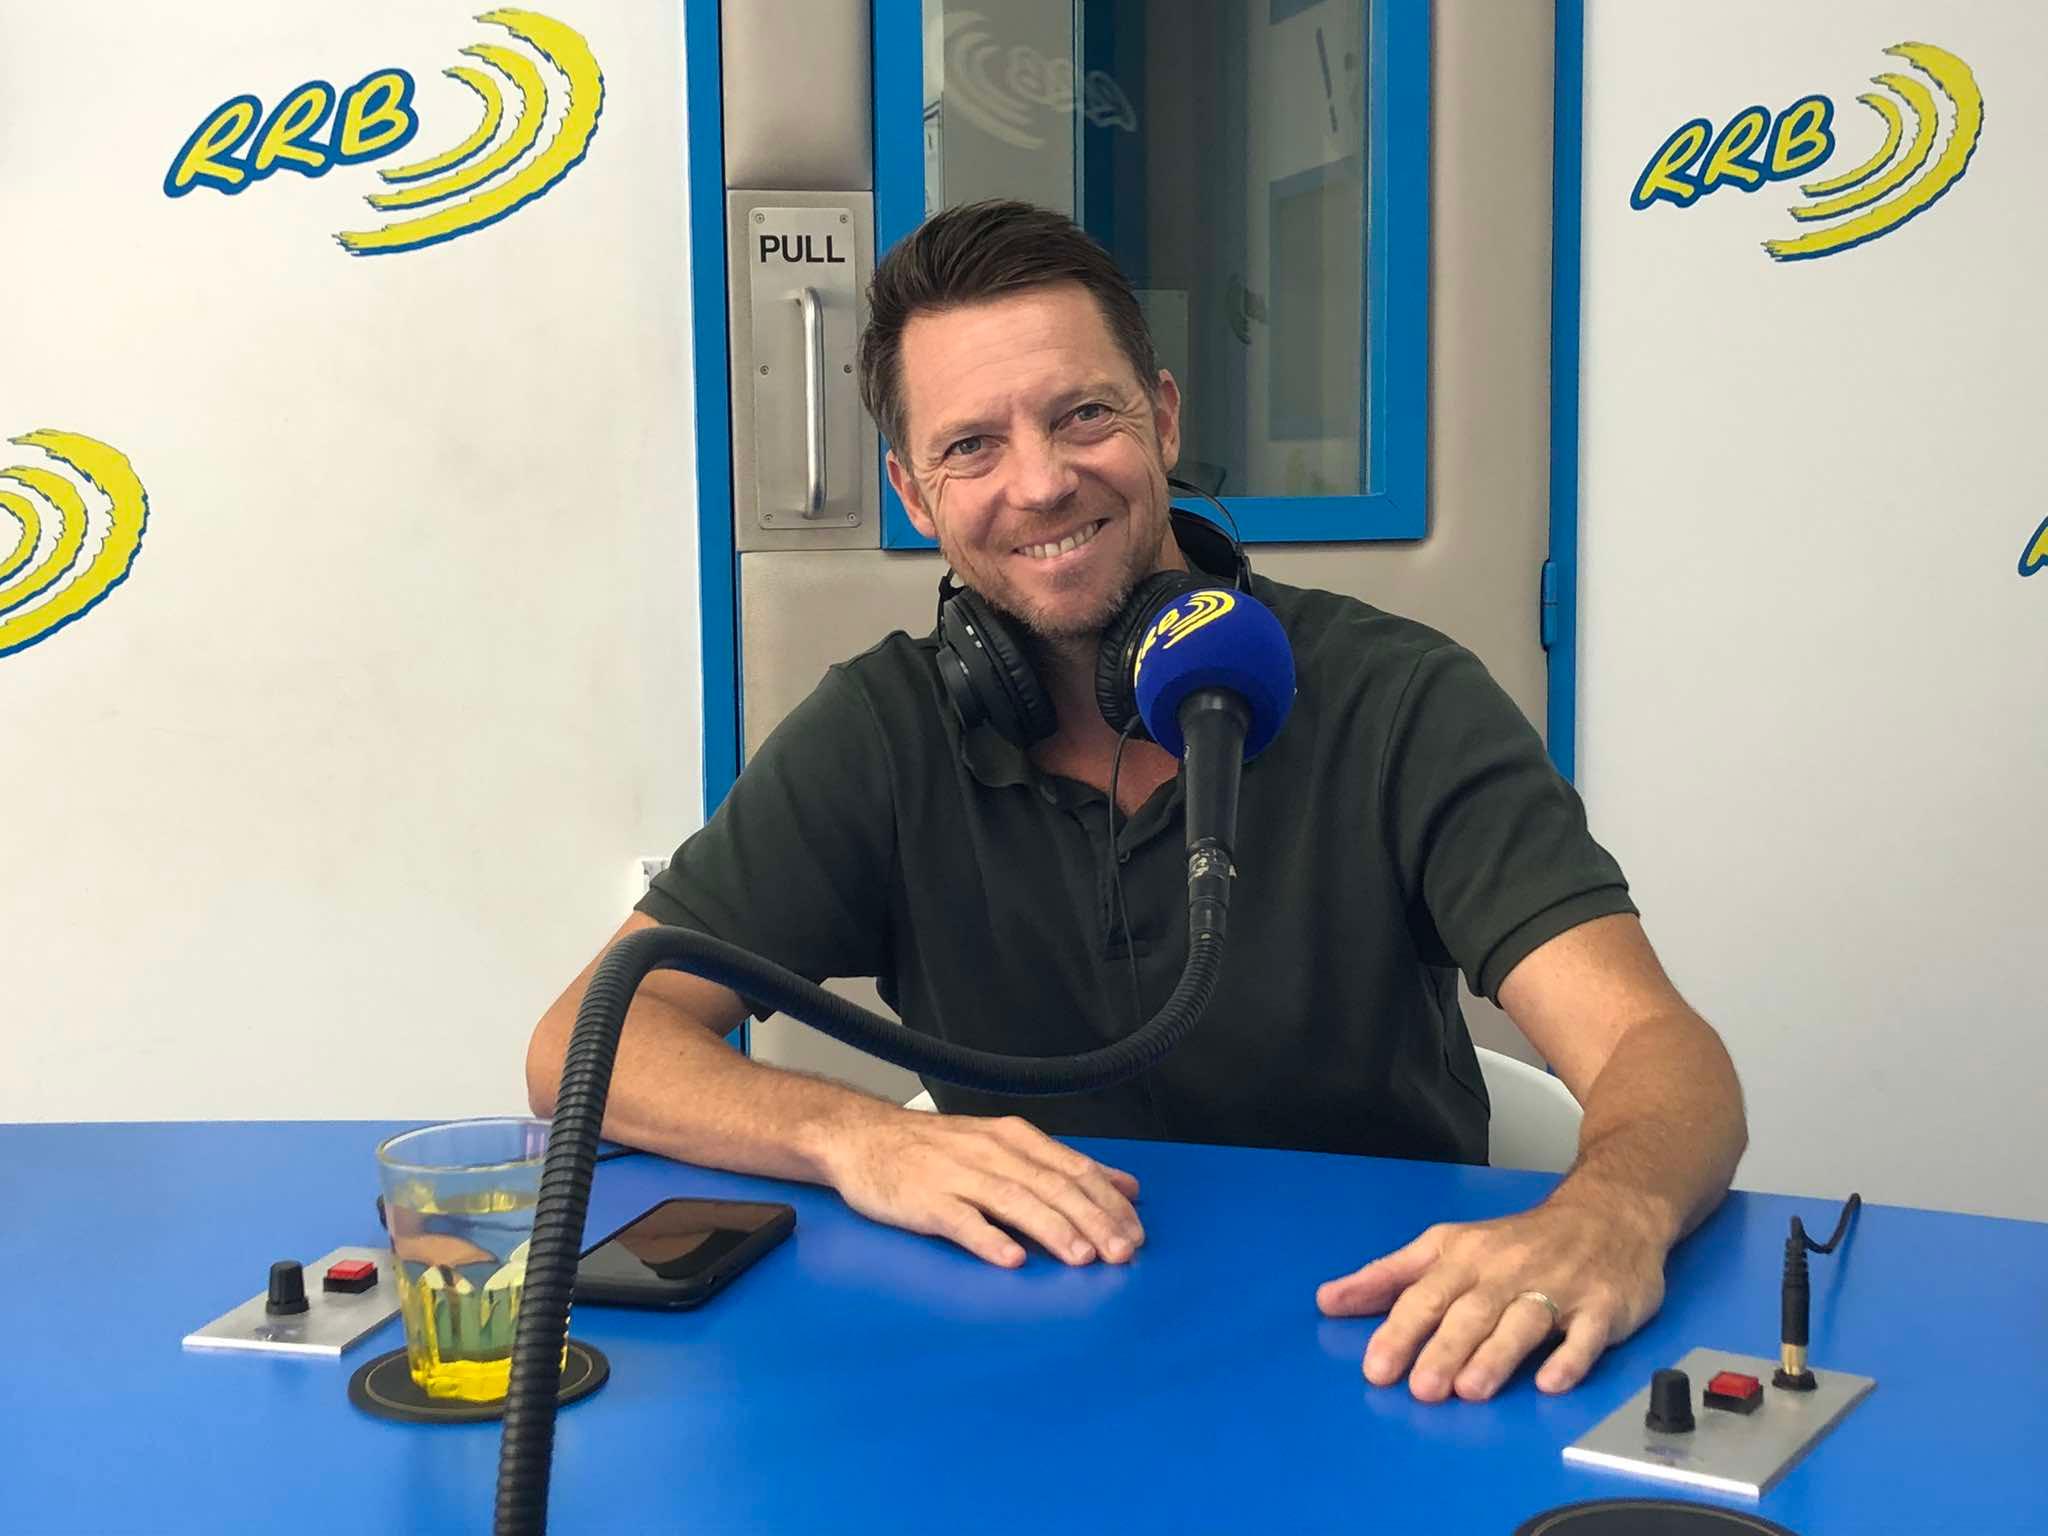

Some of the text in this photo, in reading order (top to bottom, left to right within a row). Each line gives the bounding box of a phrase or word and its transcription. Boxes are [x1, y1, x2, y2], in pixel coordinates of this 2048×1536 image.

[163, 68, 419, 198] RRB
[1630, 95, 1836, 211] RRB
[759, 234, 846, 263] PULL
